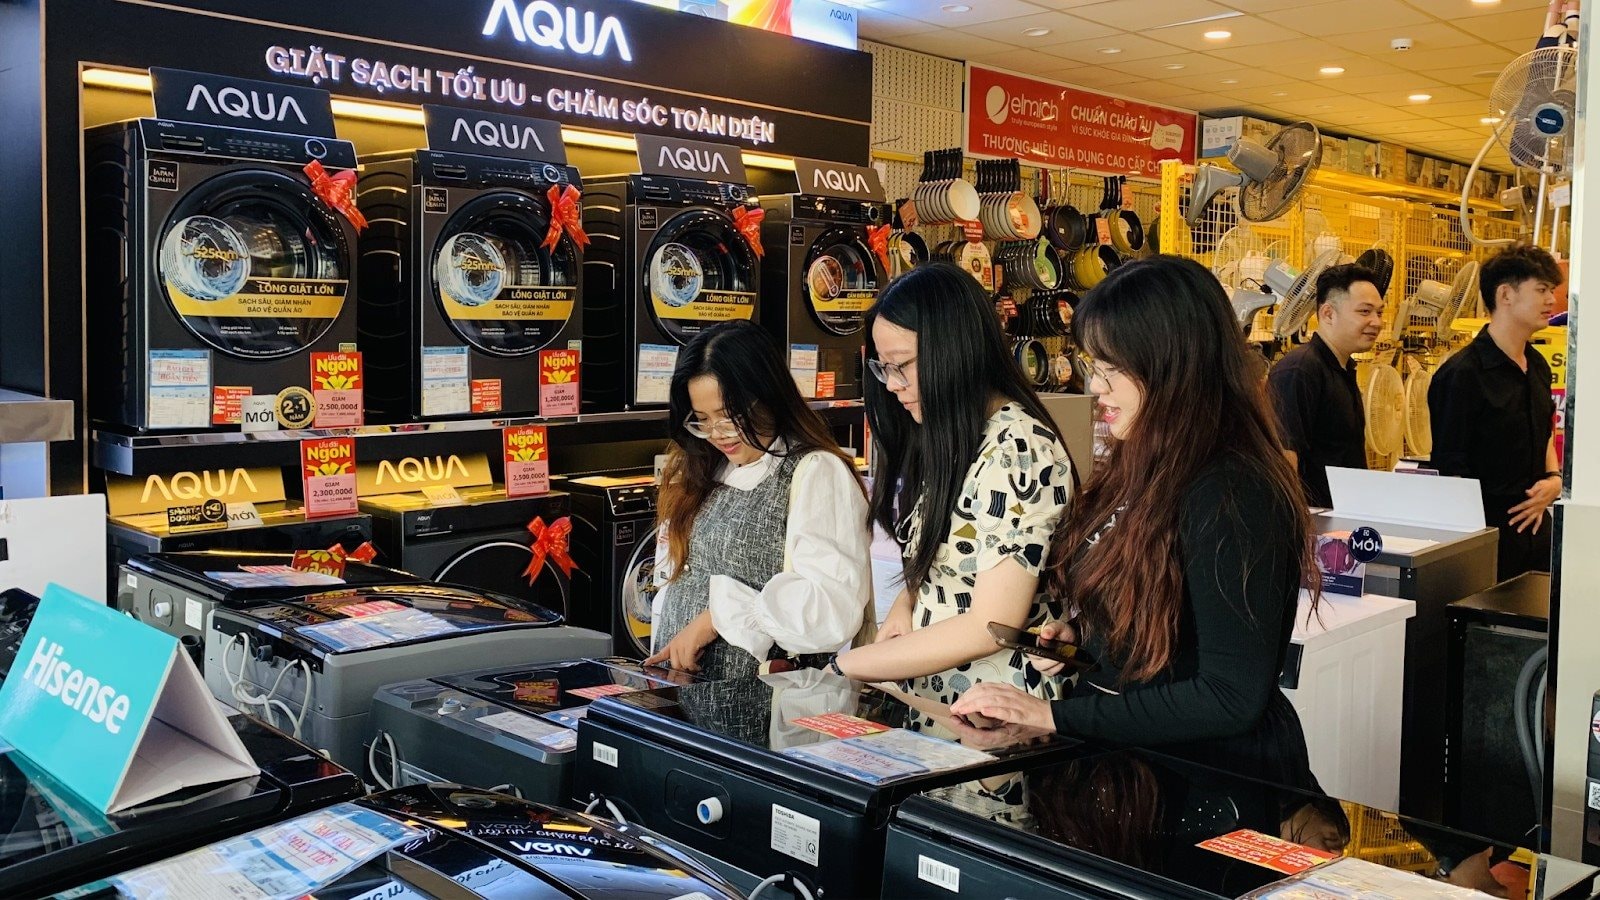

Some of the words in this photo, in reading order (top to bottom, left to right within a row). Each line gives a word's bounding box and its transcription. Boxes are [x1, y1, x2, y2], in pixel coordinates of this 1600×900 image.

[830, 8, 853, 22] AQUA
[482, 0, 632, 61] AQUA
[265, 45, 345, 85] GIẶT
[351, 58, 431, 93] SẠCH
[436, 65, 487, 101] TỐI
[490, 78, 526, 107] ƯU
[547, 88, 619, 120] CHĂM
[622, 98, 668, 126] SÓC
[671, 107, 726, 136] TOÀN
[728, 115, 775, 145] DIỆN
[186, 84, 308, 125] AQUA
[1011, 93, 1059, 121] elmich
[451, 118, 545, 152] AQUA
[983, 133, 1030, 154] THƯƠNG
[1058, 146, 1075, 160] GIA
[1077, 149, 1105, 167] DỤNG
[1106, 154, 1126, 168] CAO
[658, 146, 731, 174] AQUA
[149, 174, 176, 184] QUALITY
[153, 168, 174, 178] JAPAN
[813, 168, 871, 193] AQUA
[194, 248, 239, 260] 525mm
[289, 282, 312, 296] GIẶT
[314, 283, 334, 294] LỚN
[316, 358, 358, 376] NgoN
[543, 354, 576, 370] NgoN
[245, 409, 274, 423] MỚI
[319, 403, 358, 411] 2,500,000đ
[508, 432, 544, 449] NgoN
[307, 444, 351, 463] NgoN
[376, 454, 470, 485] AQUA
[140, 468, 258, 504] AQUA
[313, 487, 353, 497] 2,300,000đ
[24, 636, 130, 734] Hisense
[775, 808, 795, 819] TOSHIBA
